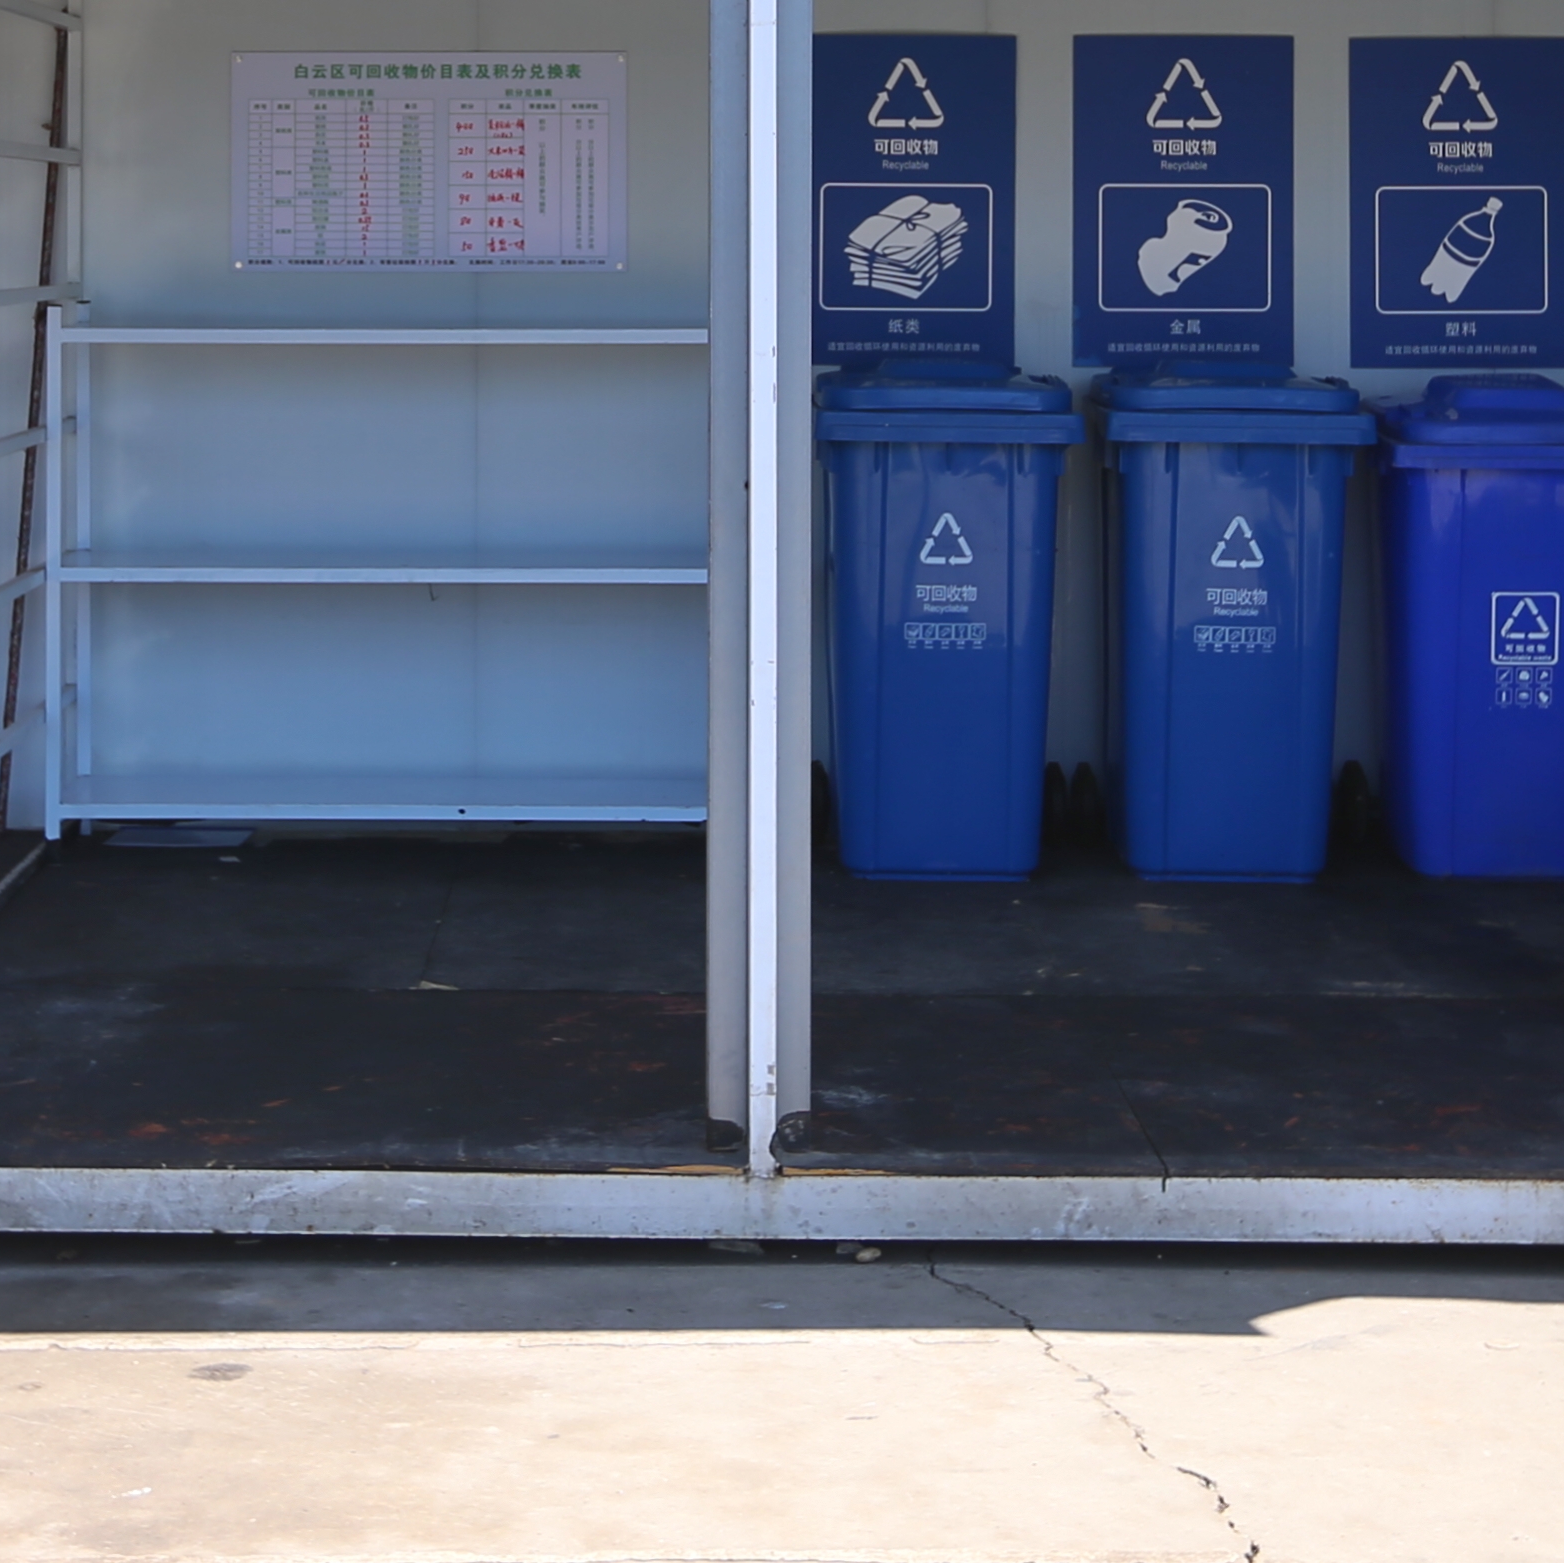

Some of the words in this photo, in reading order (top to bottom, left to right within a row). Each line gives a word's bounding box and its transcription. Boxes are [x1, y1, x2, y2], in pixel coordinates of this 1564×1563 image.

[294, 63, 582, 80] 白云区可回收物价目表及积分兑换表
[874, 139, 938, 155] 可回收物
[1152, 139, 1217, 156] 可回收物
[1429, 141, 1493, 158] 可回收物
[882, 159, 929, 171] Recyclable
[1160, 160, 1208, 172] Recyclable
[1437, 162, 1483, 174] Recyclable
[888, 319, 920, 334] 纸类
[1170, 319, 1201, 334] 金属
[1445, 322, 1477, 337] 塑料
[916, 584, 977, 602] 可回收物
[1206, 588, 1268, 605] 可回收物
[923, 603, 969, 615] Recyclable
[1213, 606, 1259, 618] Recyclable
